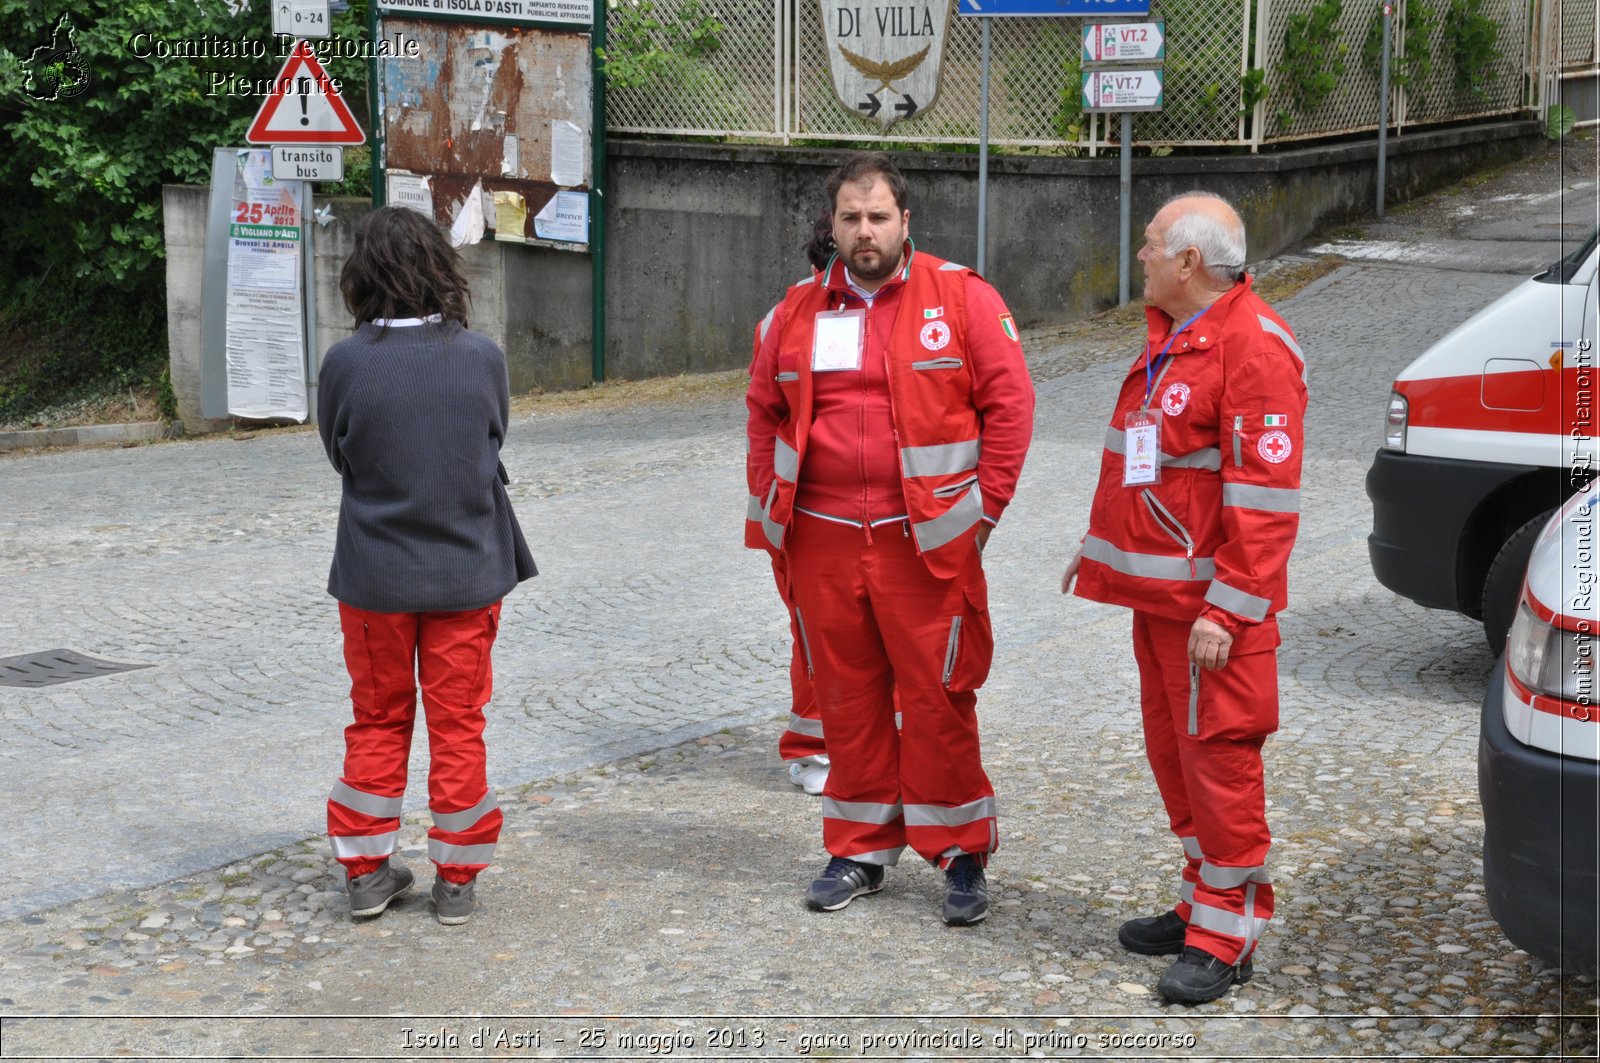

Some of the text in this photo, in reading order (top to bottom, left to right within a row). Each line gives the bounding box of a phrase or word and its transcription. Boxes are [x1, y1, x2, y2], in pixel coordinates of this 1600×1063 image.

[447, 0, 481, 12] ISOLA
[485, 0, 523, 15] D'ASTI
[529, 1, 589, 11] IMPIANTO RISERVATO
[527, 9, 591, 20] PUBBLICHE AFFISSIONI
[838, 6, 935, 38] DI VILLA
[1120, 29, 1148, 42] VT.2
[1115, 77, 1142, 90] VT.7
[281, 149, 333, 163] transito
[296, 164, 318, 178] bus
[236, 201, 295, 224] 25 Aprile
[274, 217, 295, 226] 2013
[240, 226, 273, 239] VIGLIANO
